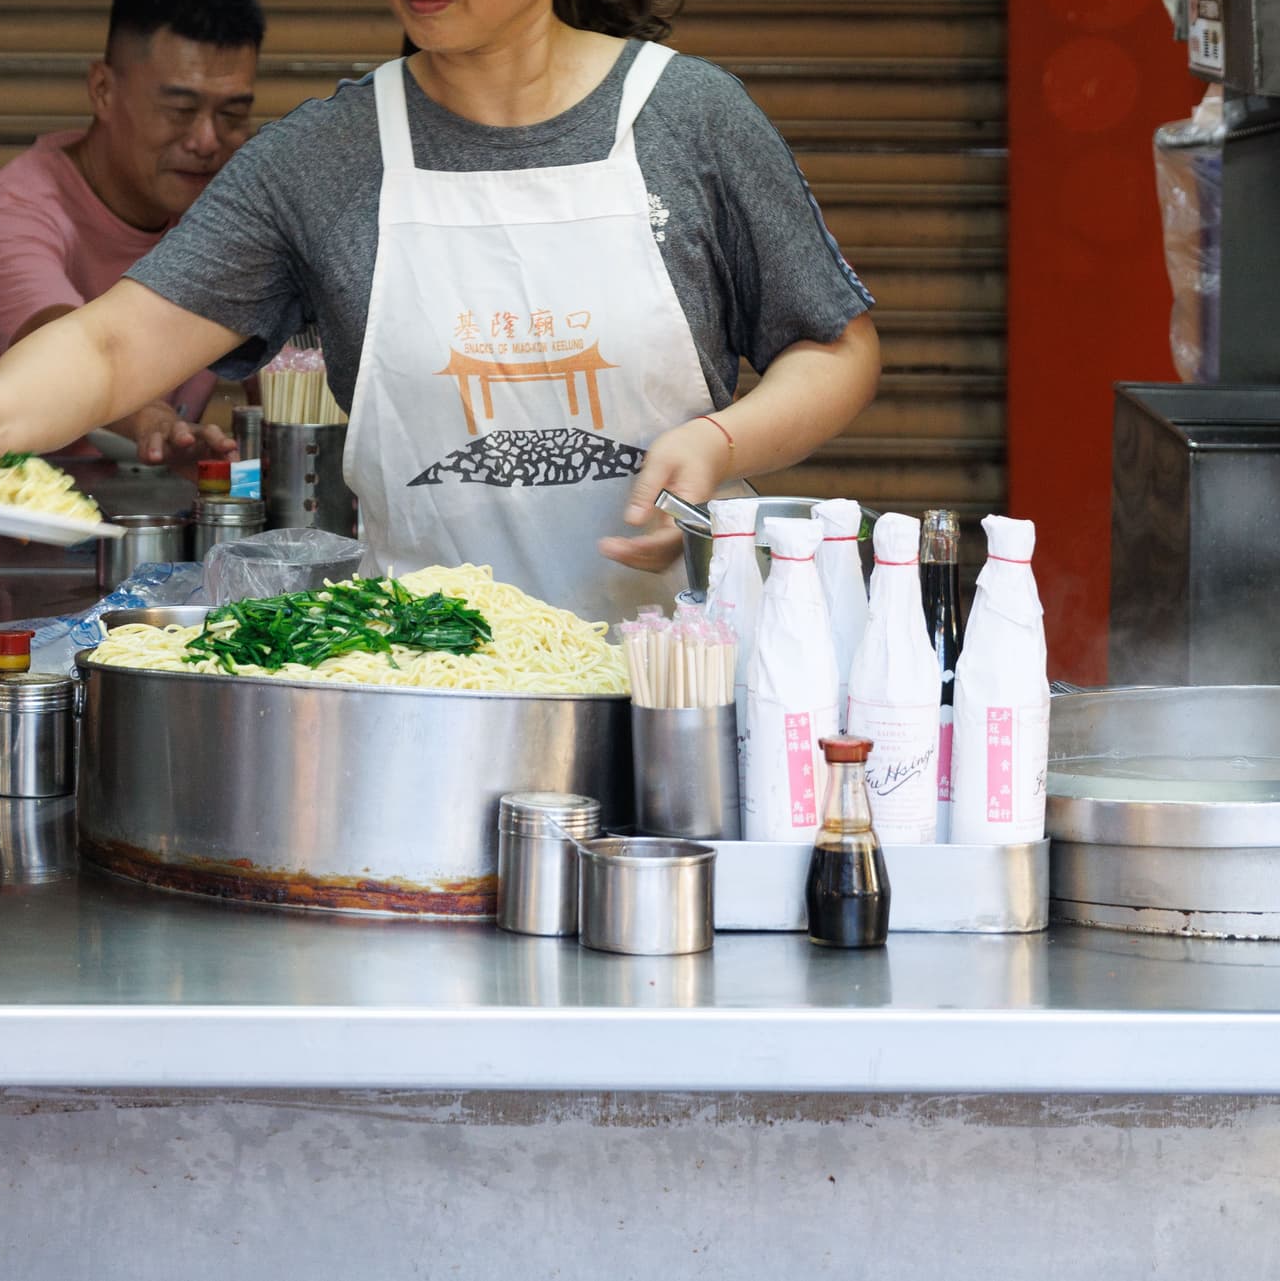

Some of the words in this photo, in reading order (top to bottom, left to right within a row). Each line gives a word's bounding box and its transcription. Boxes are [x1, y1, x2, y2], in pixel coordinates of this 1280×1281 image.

[454, 308, 592, 341] 基隆廟口
[464, 342, 494, 355] SNACKS
[498, 343, 509, 354] OF
